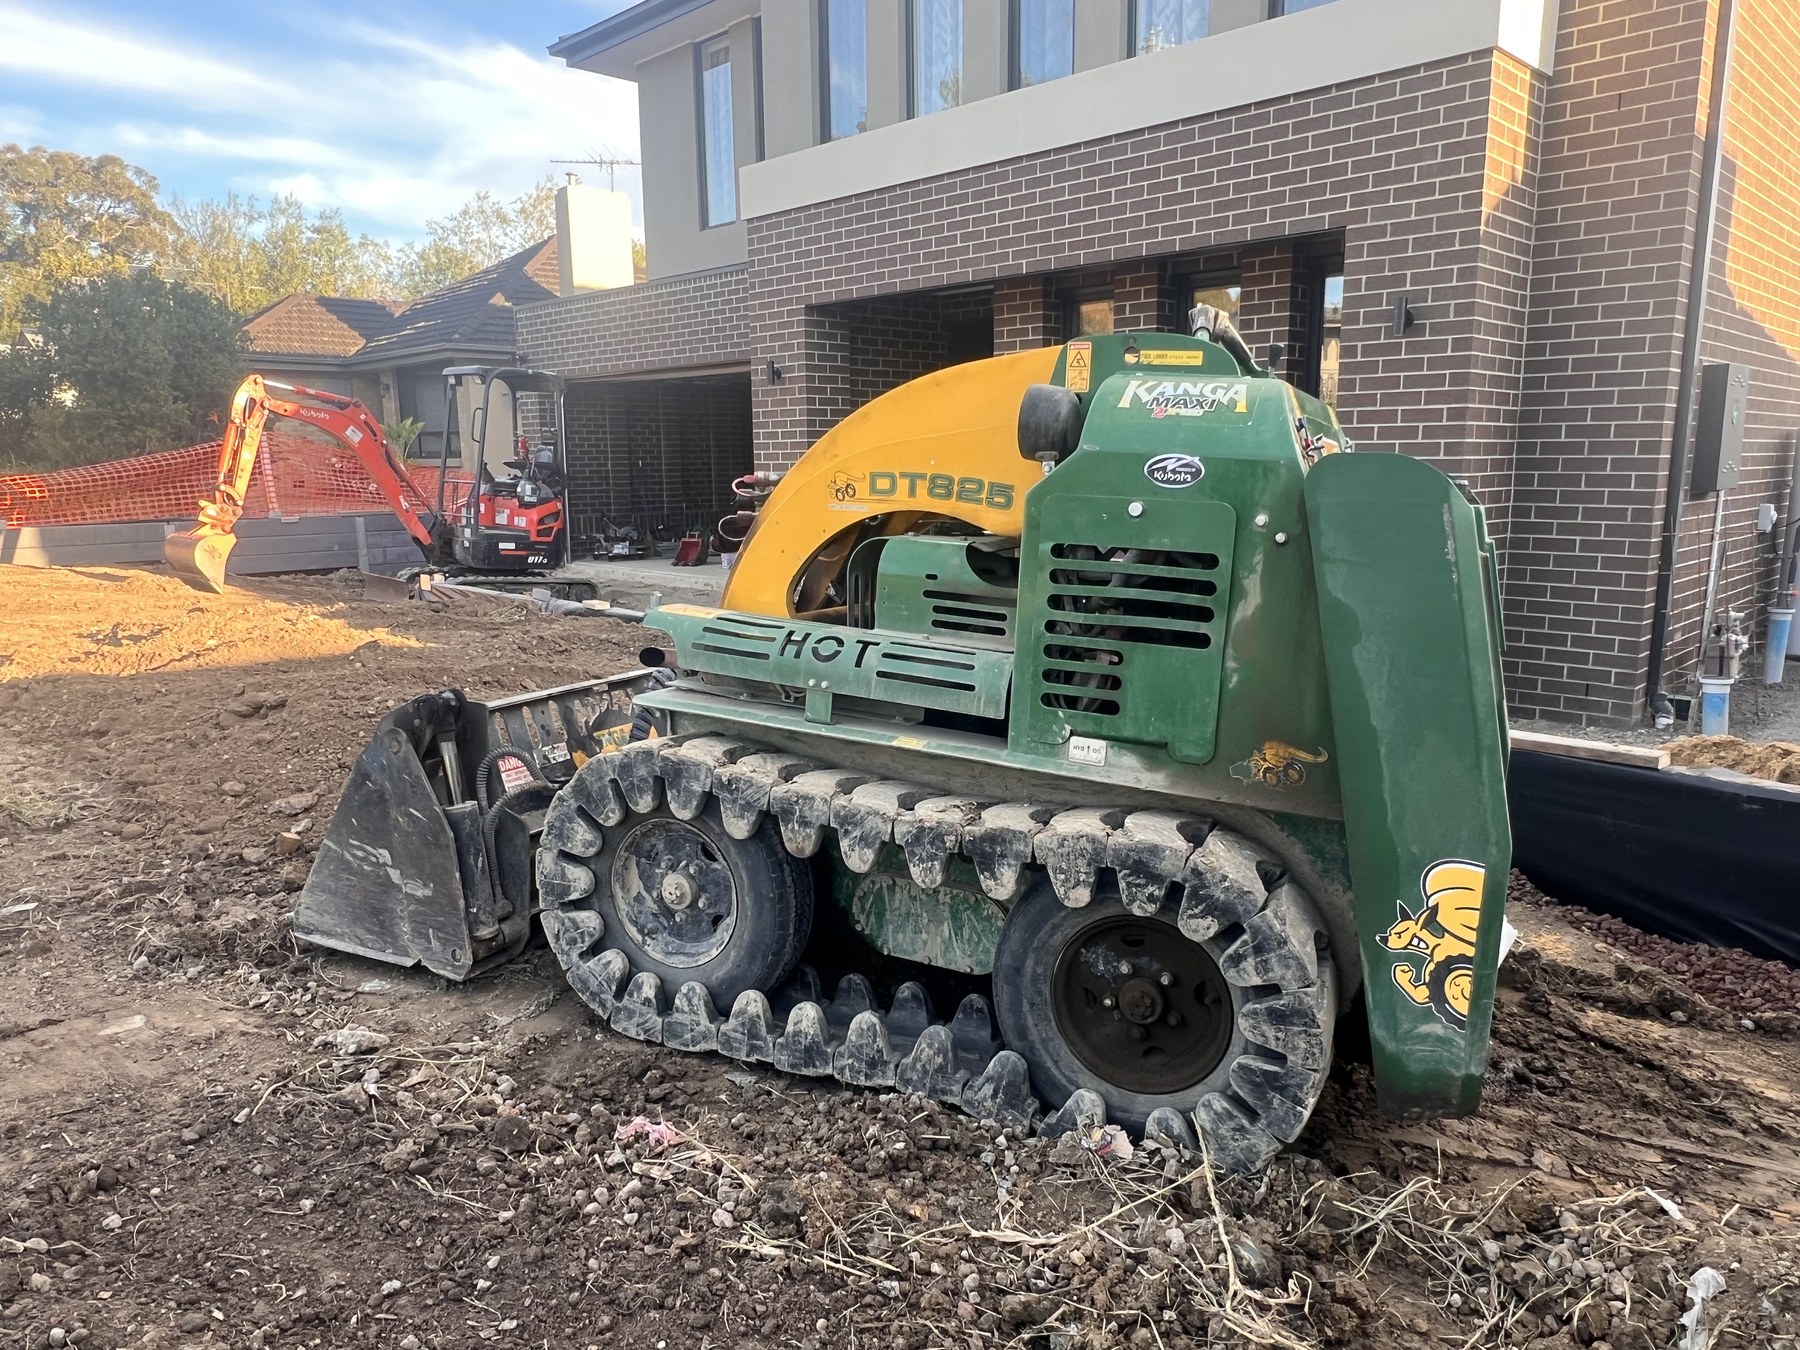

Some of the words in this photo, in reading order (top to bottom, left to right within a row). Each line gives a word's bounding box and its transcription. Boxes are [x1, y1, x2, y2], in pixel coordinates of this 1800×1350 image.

[1117, 380, 1248, 413] KANGA
[1147, 396, 1218, 411] MAXI
[1154, 470, 1191, 482] Kubota
[869, 472, 1014, 510] DT825
[779, 629, 880, 669] HOT
[499, 757, 525, 772] DANG
